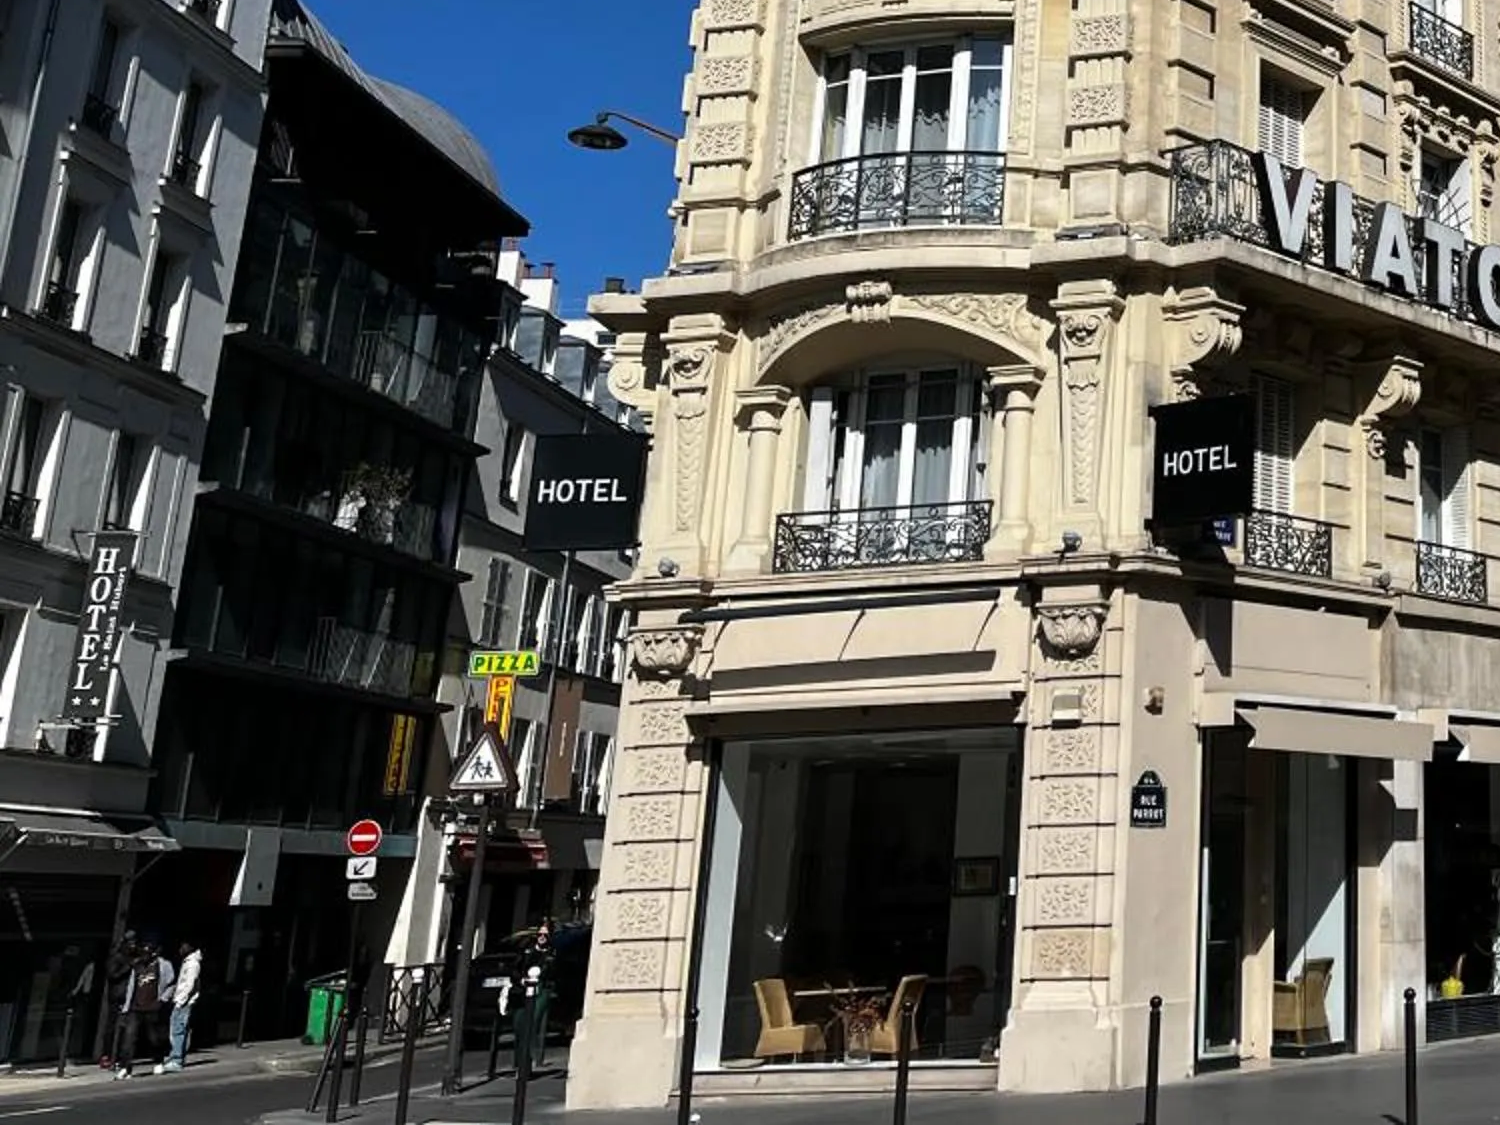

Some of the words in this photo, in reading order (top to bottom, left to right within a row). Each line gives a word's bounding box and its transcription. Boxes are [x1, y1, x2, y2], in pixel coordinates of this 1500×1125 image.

[1163, 444, 1237, 477] HOTEL
[537, 478, 627, 503] HOTEL
[73, 547, 120, 690] HOTEL
[474, 655, 535, 672] PIZZA
